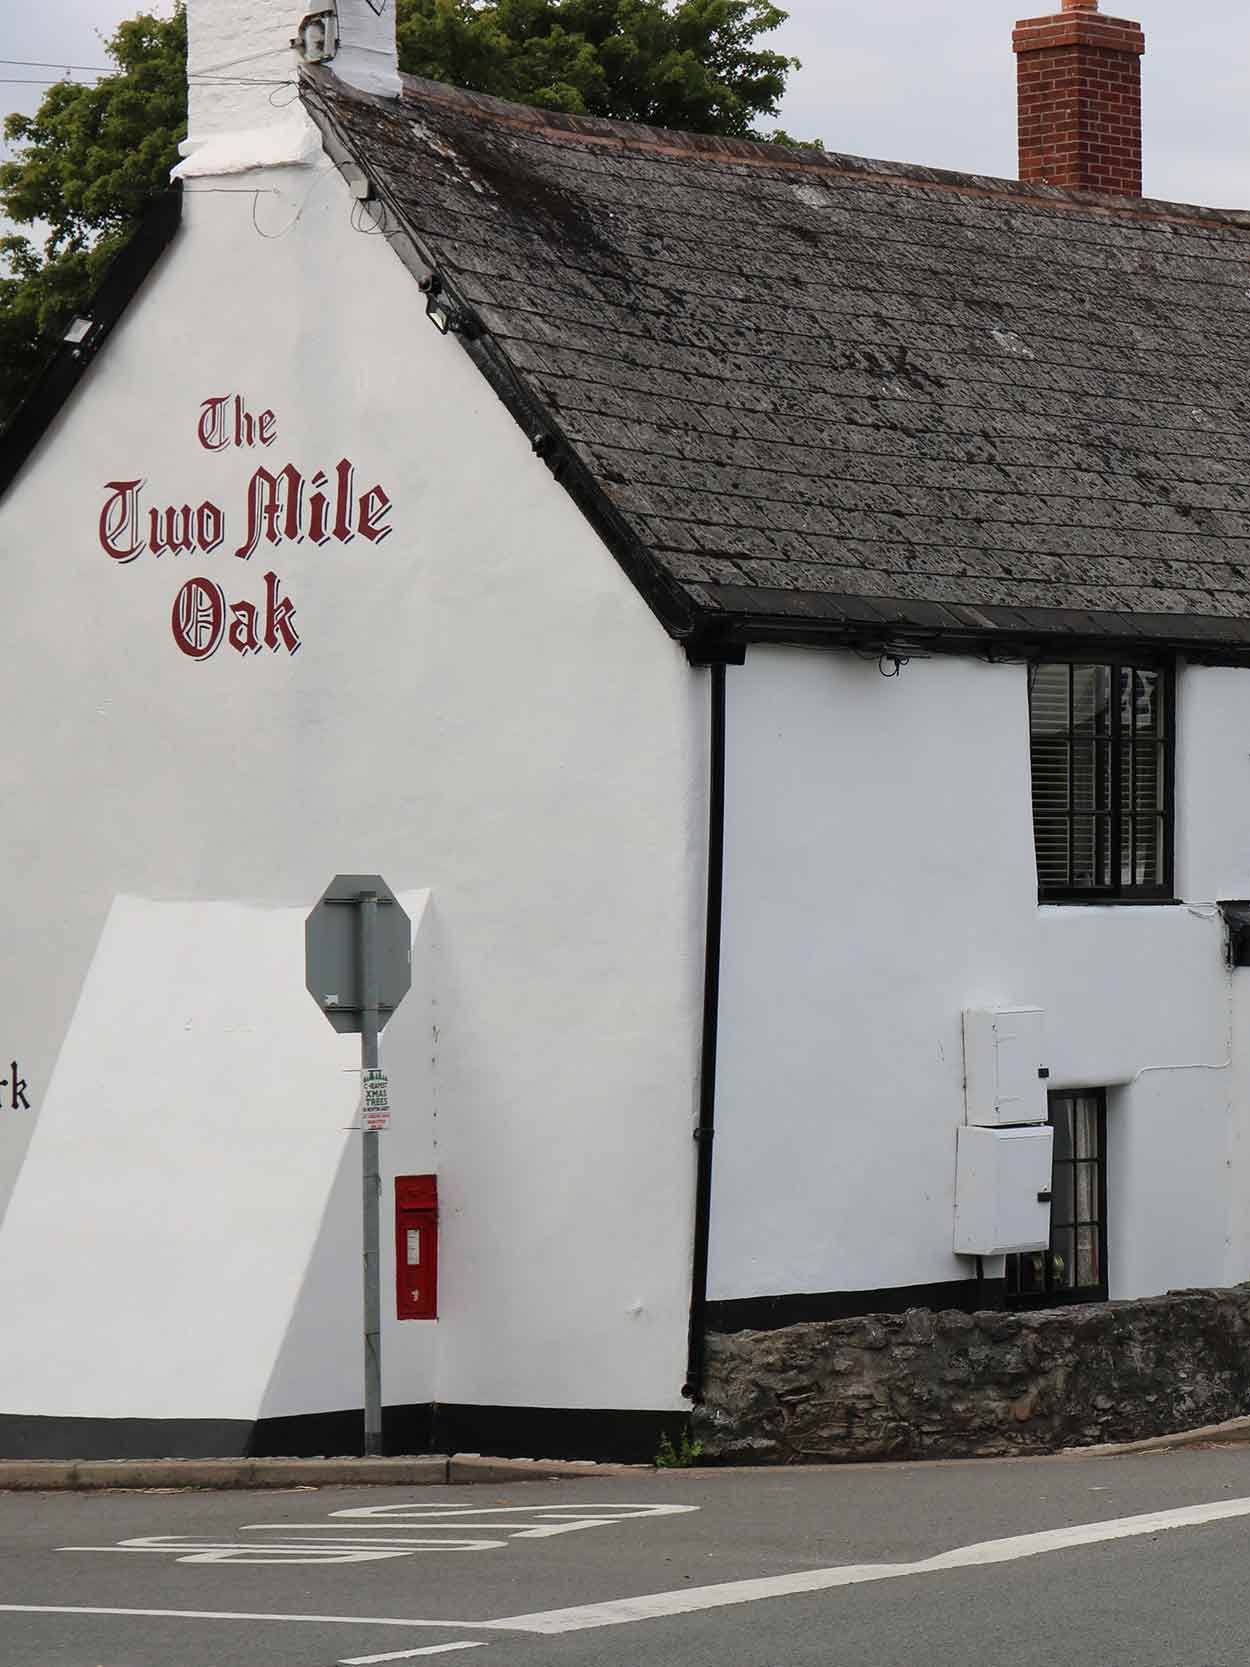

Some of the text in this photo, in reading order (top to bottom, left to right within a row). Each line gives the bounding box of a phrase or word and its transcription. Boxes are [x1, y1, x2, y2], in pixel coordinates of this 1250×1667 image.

[198, 392, 278, 453] The
[99, 457, 393, 564] Two Mile
[171, 570, 302, 662] Oak
